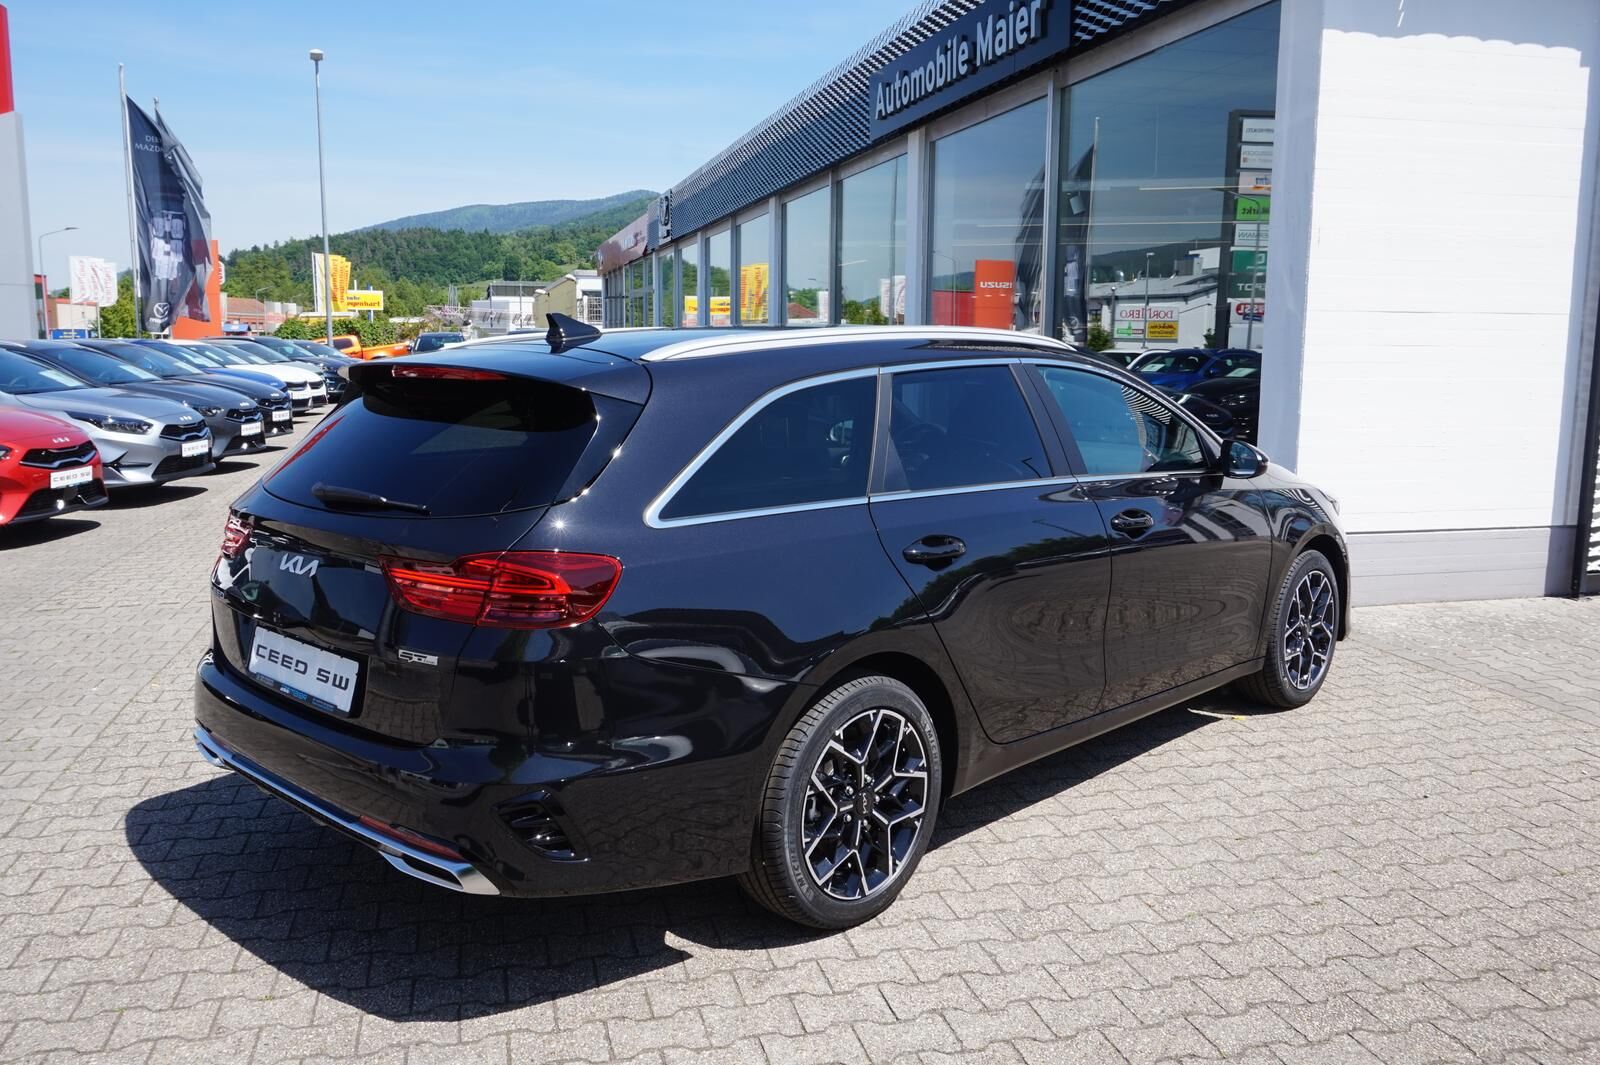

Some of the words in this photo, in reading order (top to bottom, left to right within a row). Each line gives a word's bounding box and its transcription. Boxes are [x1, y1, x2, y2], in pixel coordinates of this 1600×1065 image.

[874, 34, 970, 121] Automobile
[975, 0, 1042, 67] Maier
[280, 553, 319, 577] KIA
[256, 644, 308, 676] CEED
[316, 667, 350, 691] SW
